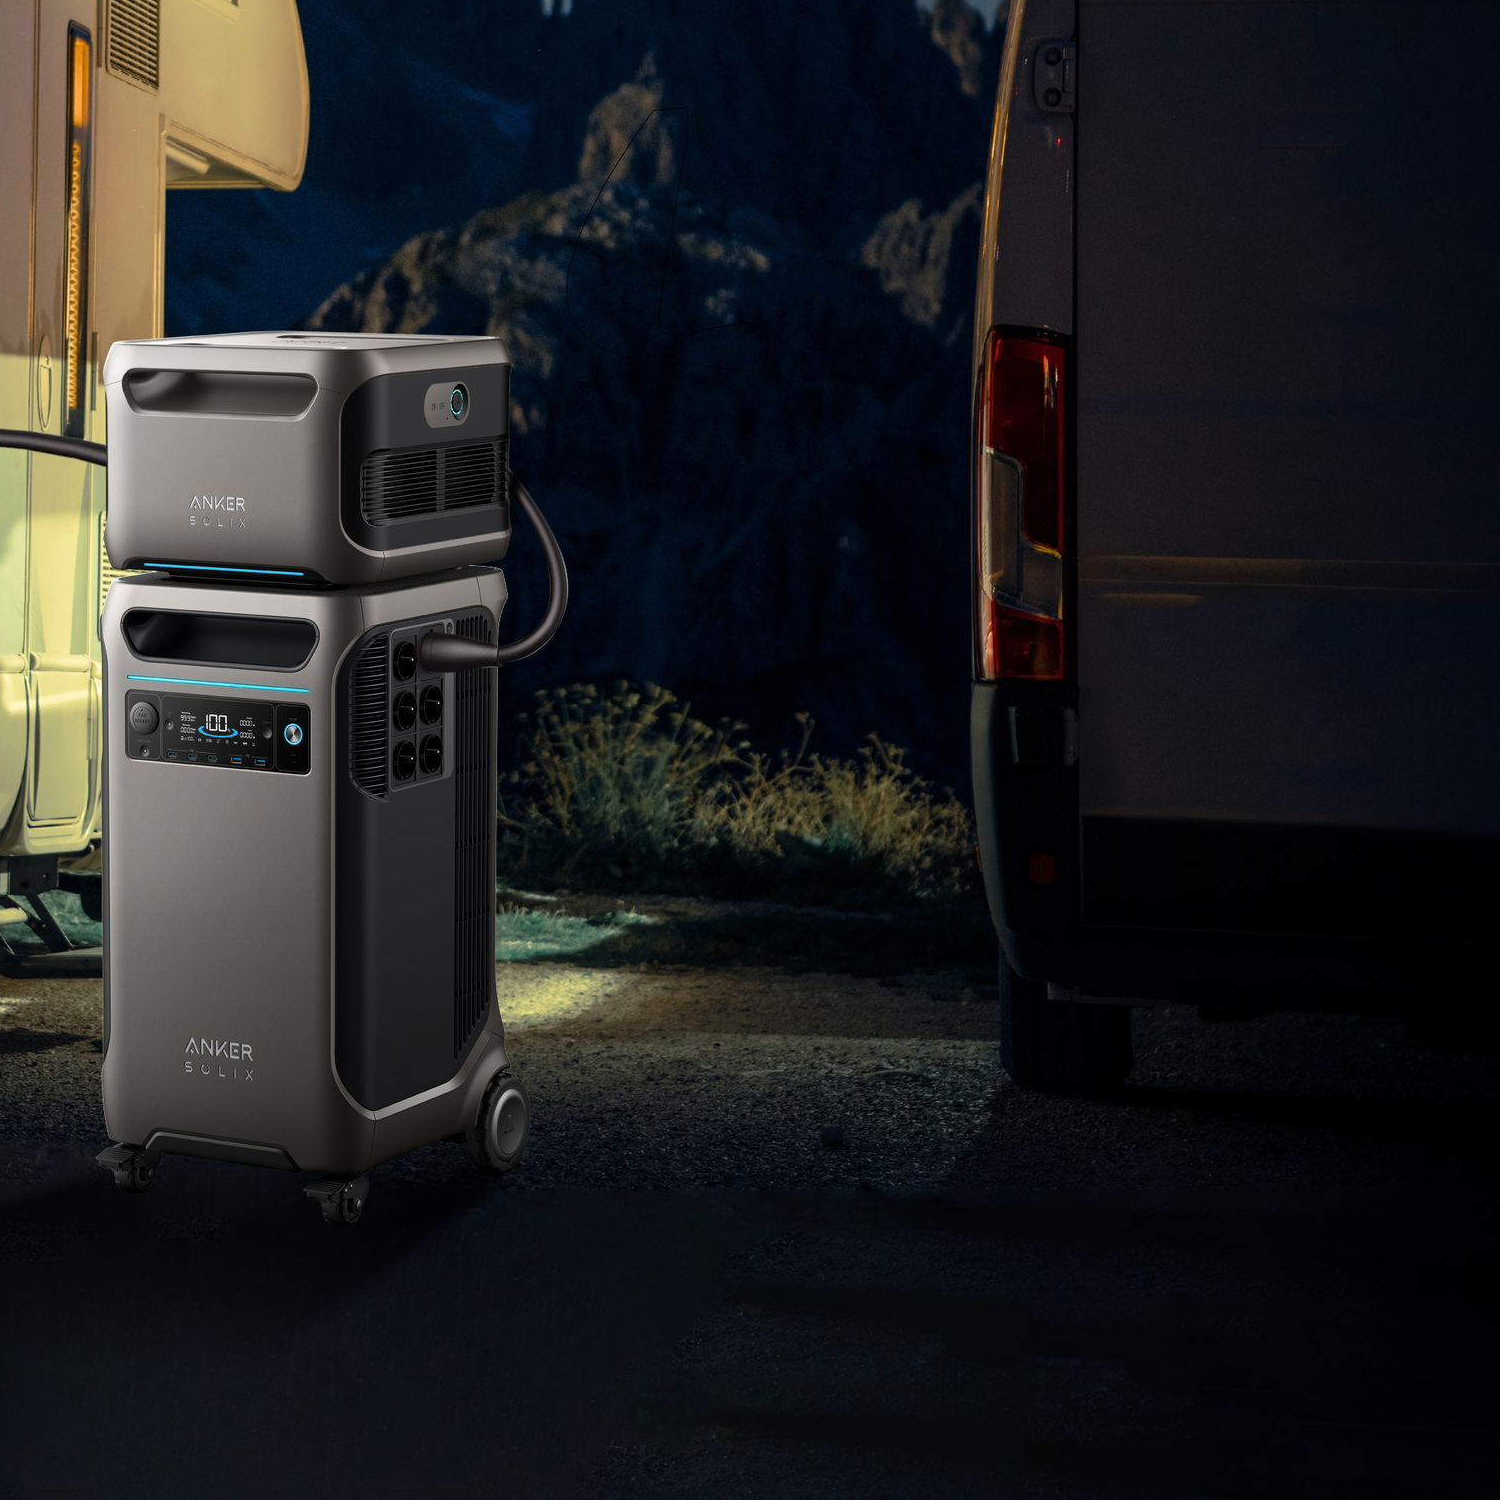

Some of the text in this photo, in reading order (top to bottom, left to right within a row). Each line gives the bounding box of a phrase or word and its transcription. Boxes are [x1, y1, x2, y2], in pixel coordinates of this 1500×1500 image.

[189, 495, 246, 512] ANKER
[189, 515, 246, 528] SOLIX
[184, 1037, 254, 1062] ANKER
[184, 1061, 254, 1082] SOLIX
